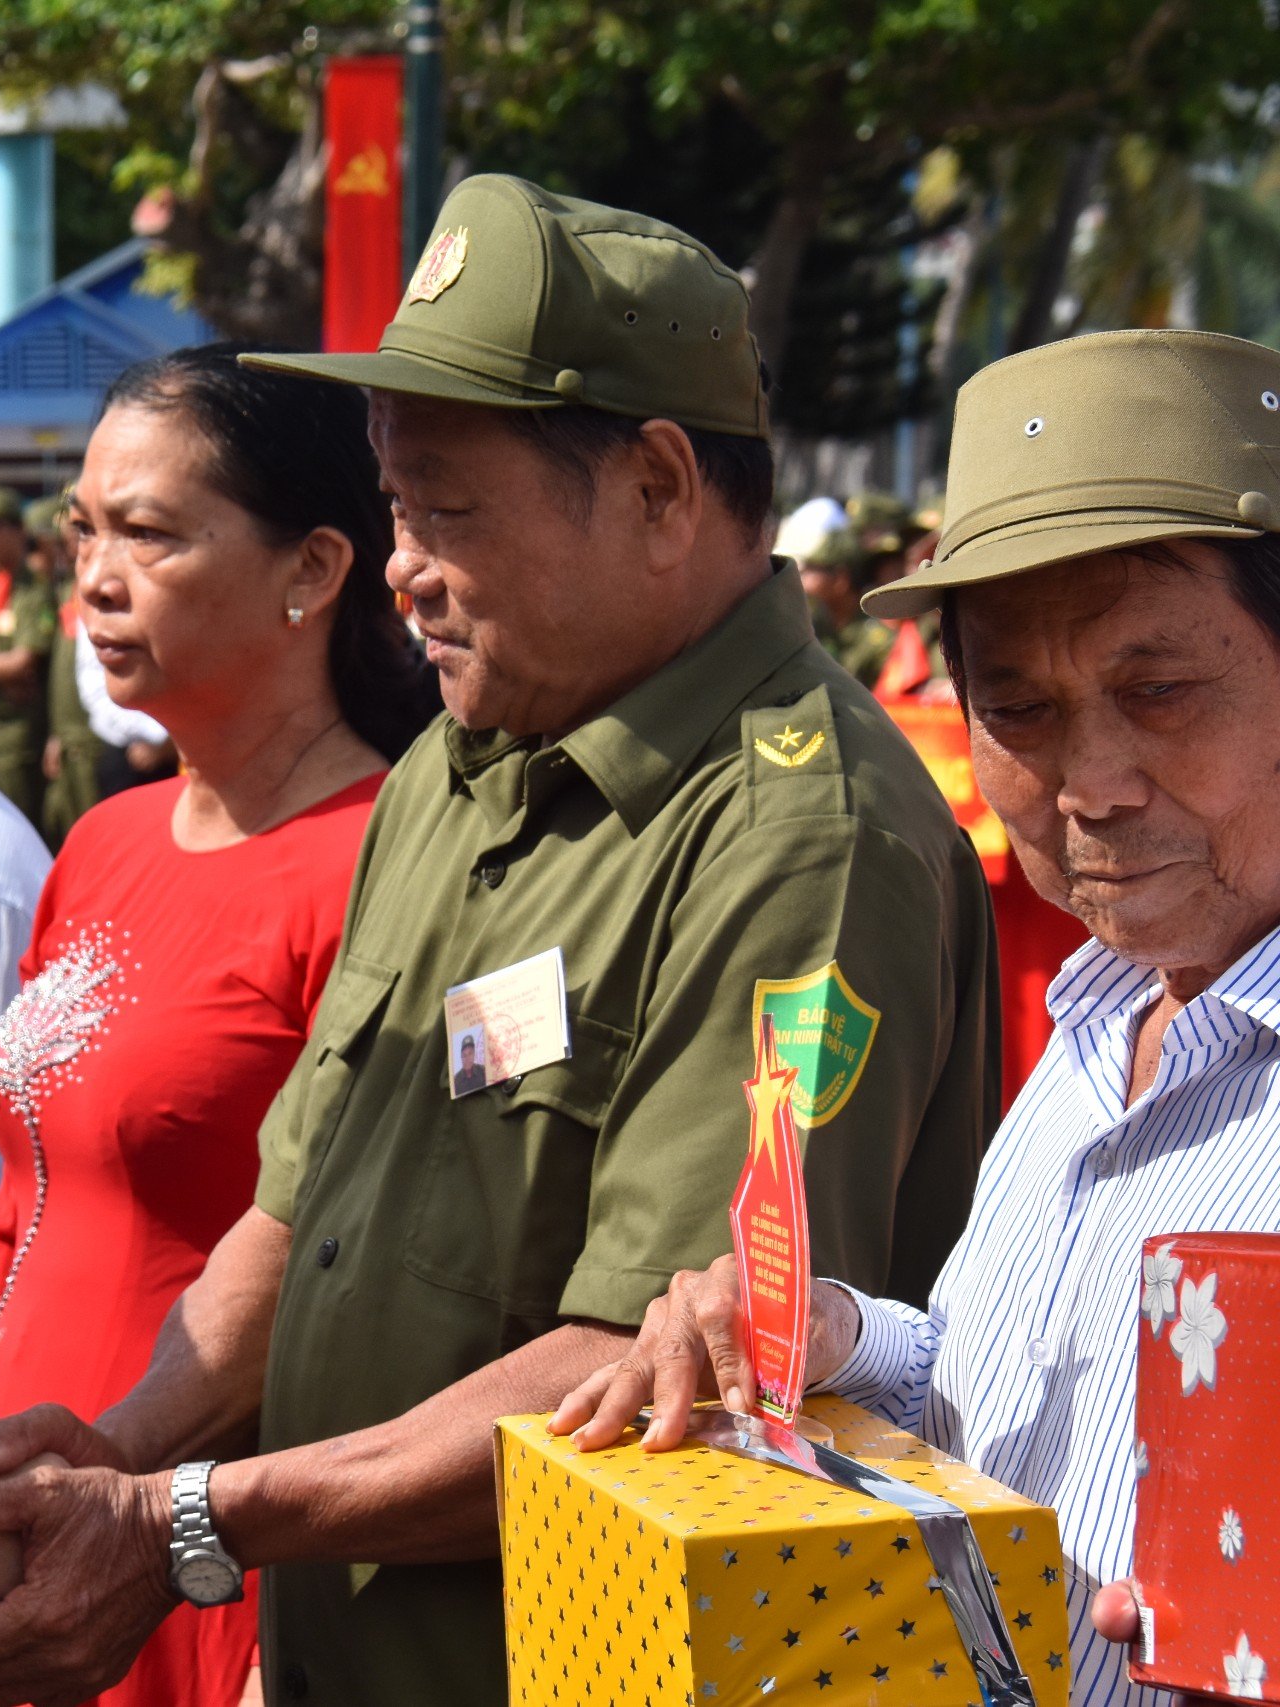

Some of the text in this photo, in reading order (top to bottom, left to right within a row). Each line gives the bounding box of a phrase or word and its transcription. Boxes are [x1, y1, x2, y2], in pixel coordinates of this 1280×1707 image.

[797, 1004, 846, 1037] BẢO VỆ
[774, 1029, 858, 1066] AN NINH TRẬT TỰ
